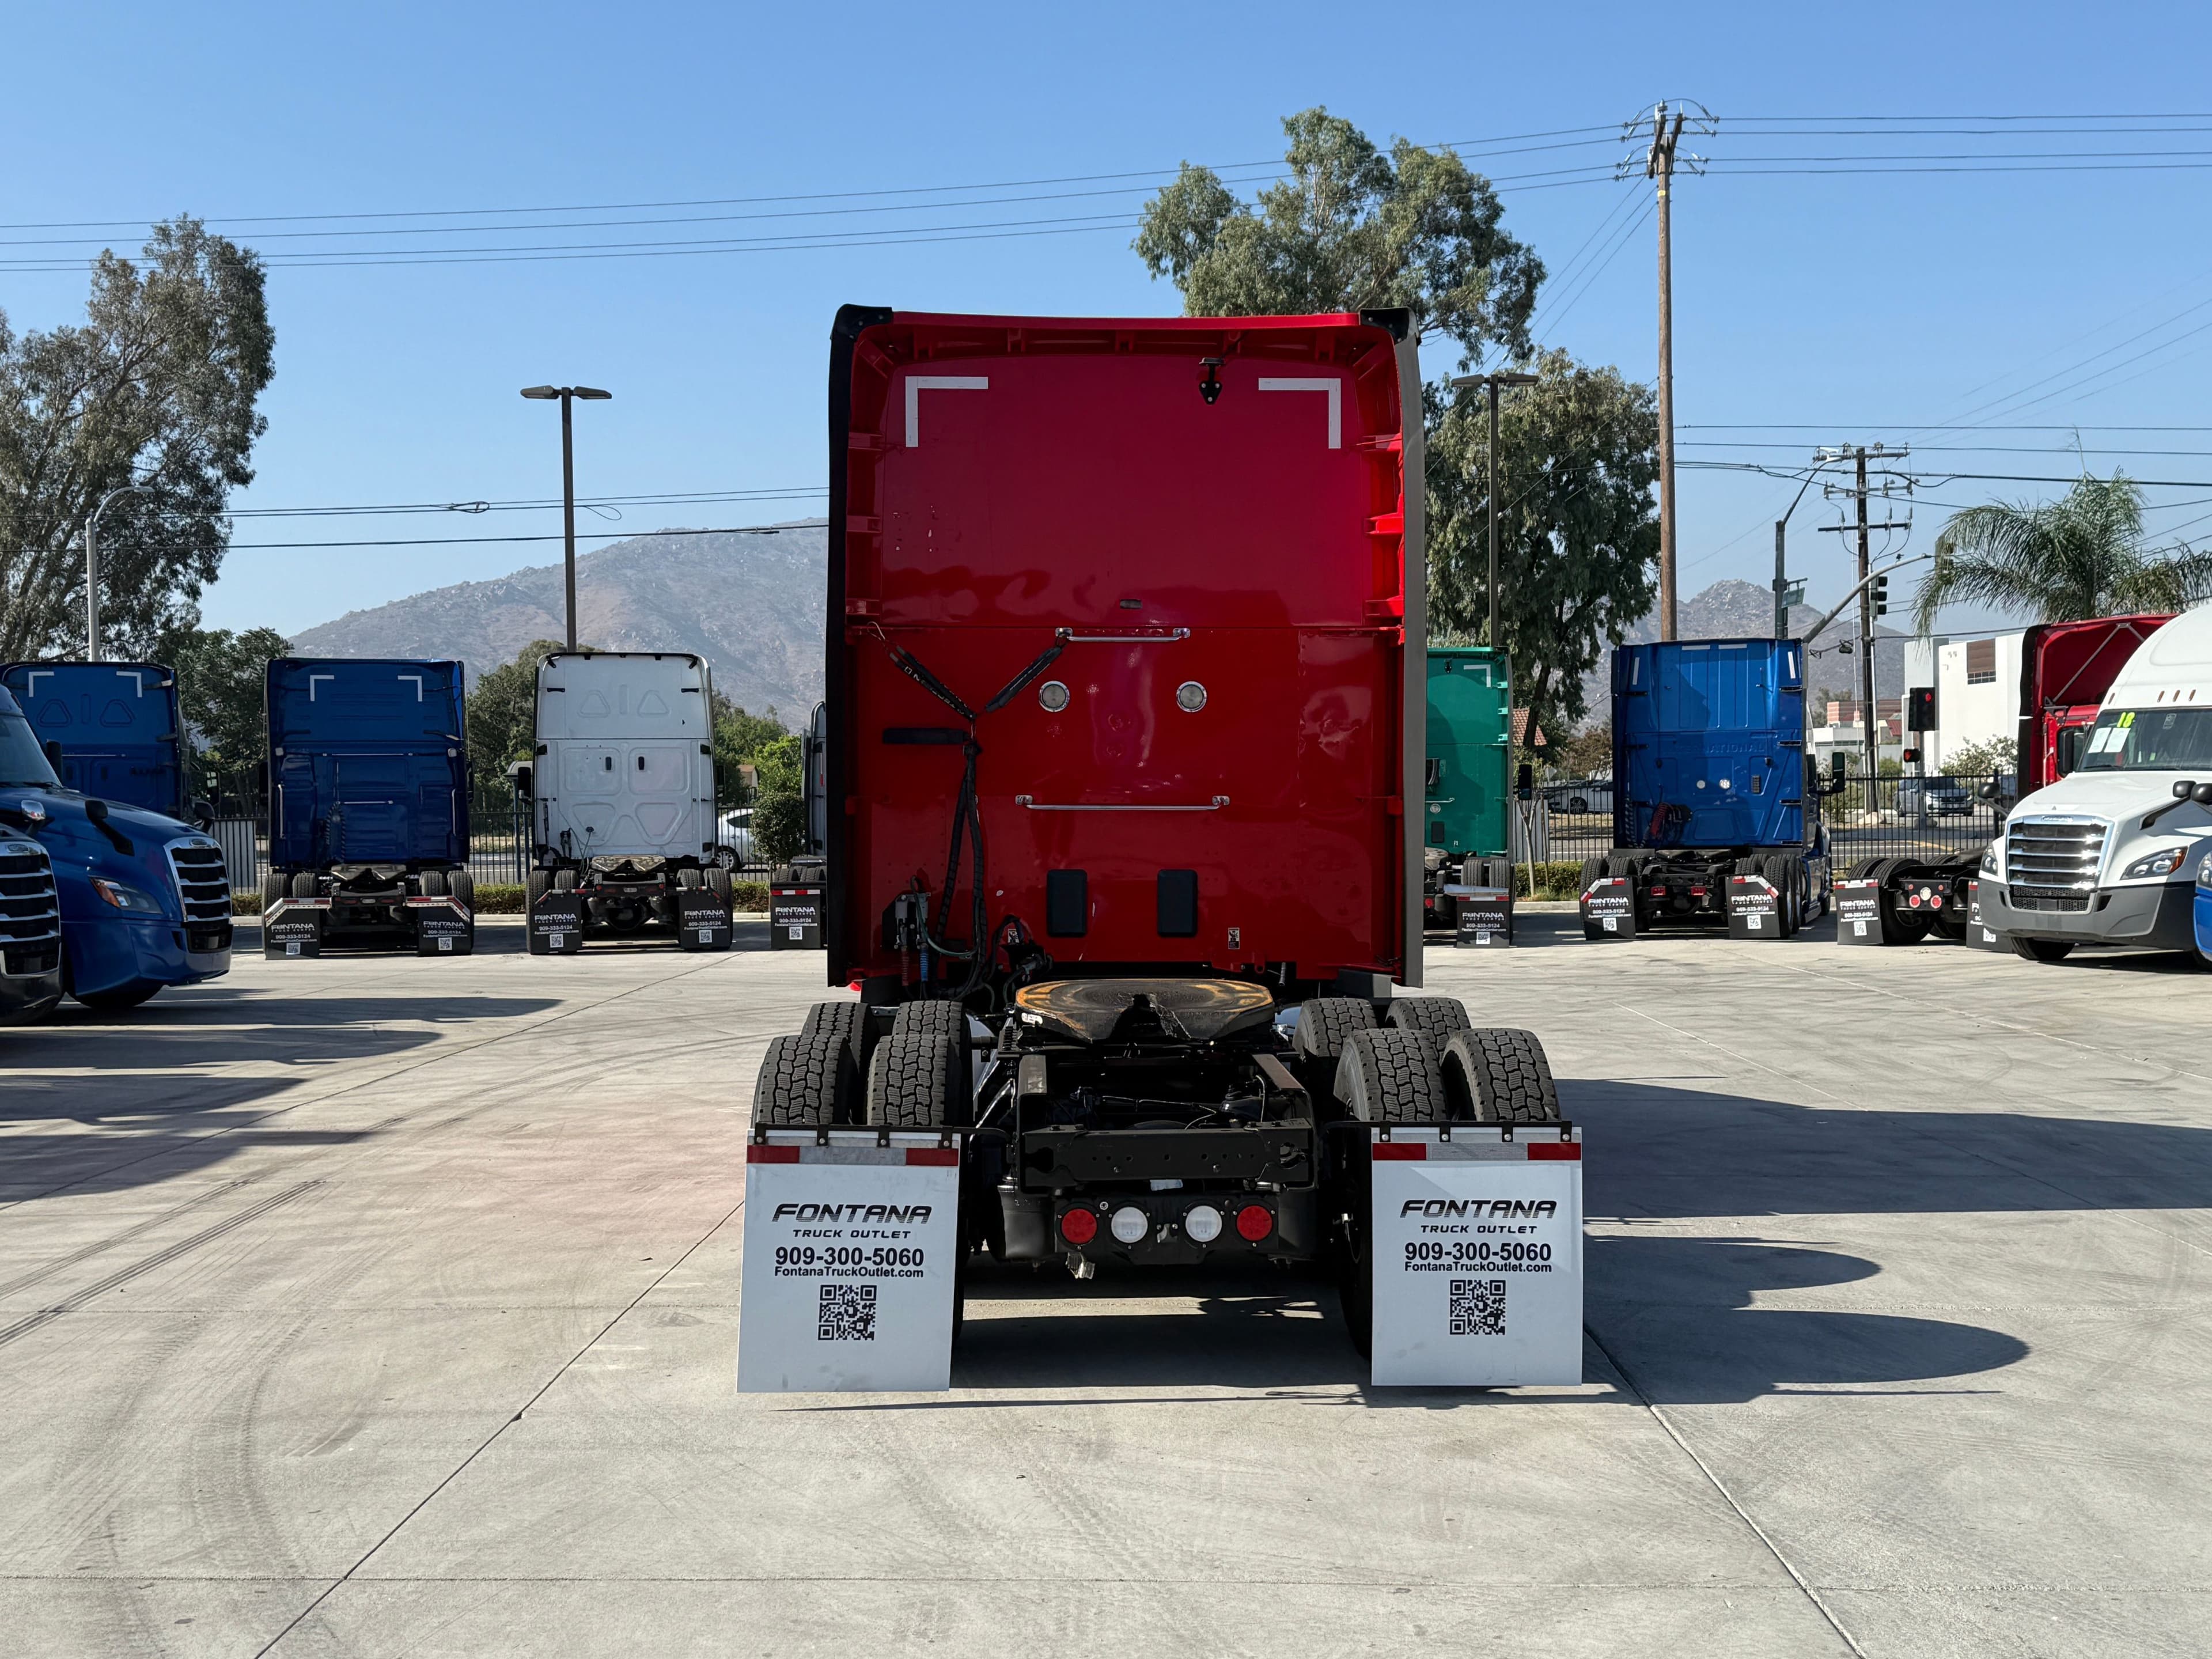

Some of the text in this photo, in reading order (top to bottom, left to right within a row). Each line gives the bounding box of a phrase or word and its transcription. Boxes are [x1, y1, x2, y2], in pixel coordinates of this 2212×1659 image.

[2116, 711, 2136, 728] 18
[772, 1203, 932, 1224] FONTANA
[1400, 1199, 1557, 1219] FONTANA
[793, 1229, 911, 1238] TRUCK OUTLET
[1421, 1225, 1537, 1234] TRUCK OUTLET
[775, 1246, 924, 1266] 909-300-5060
[1405, 1242, 1551, 1262] 909-300-5060
[774, 1266, 924, 1278] FontanaTruckOutlet.com
[1404, 1261, 1552, 1272] FontanaTruckOutlet.com
